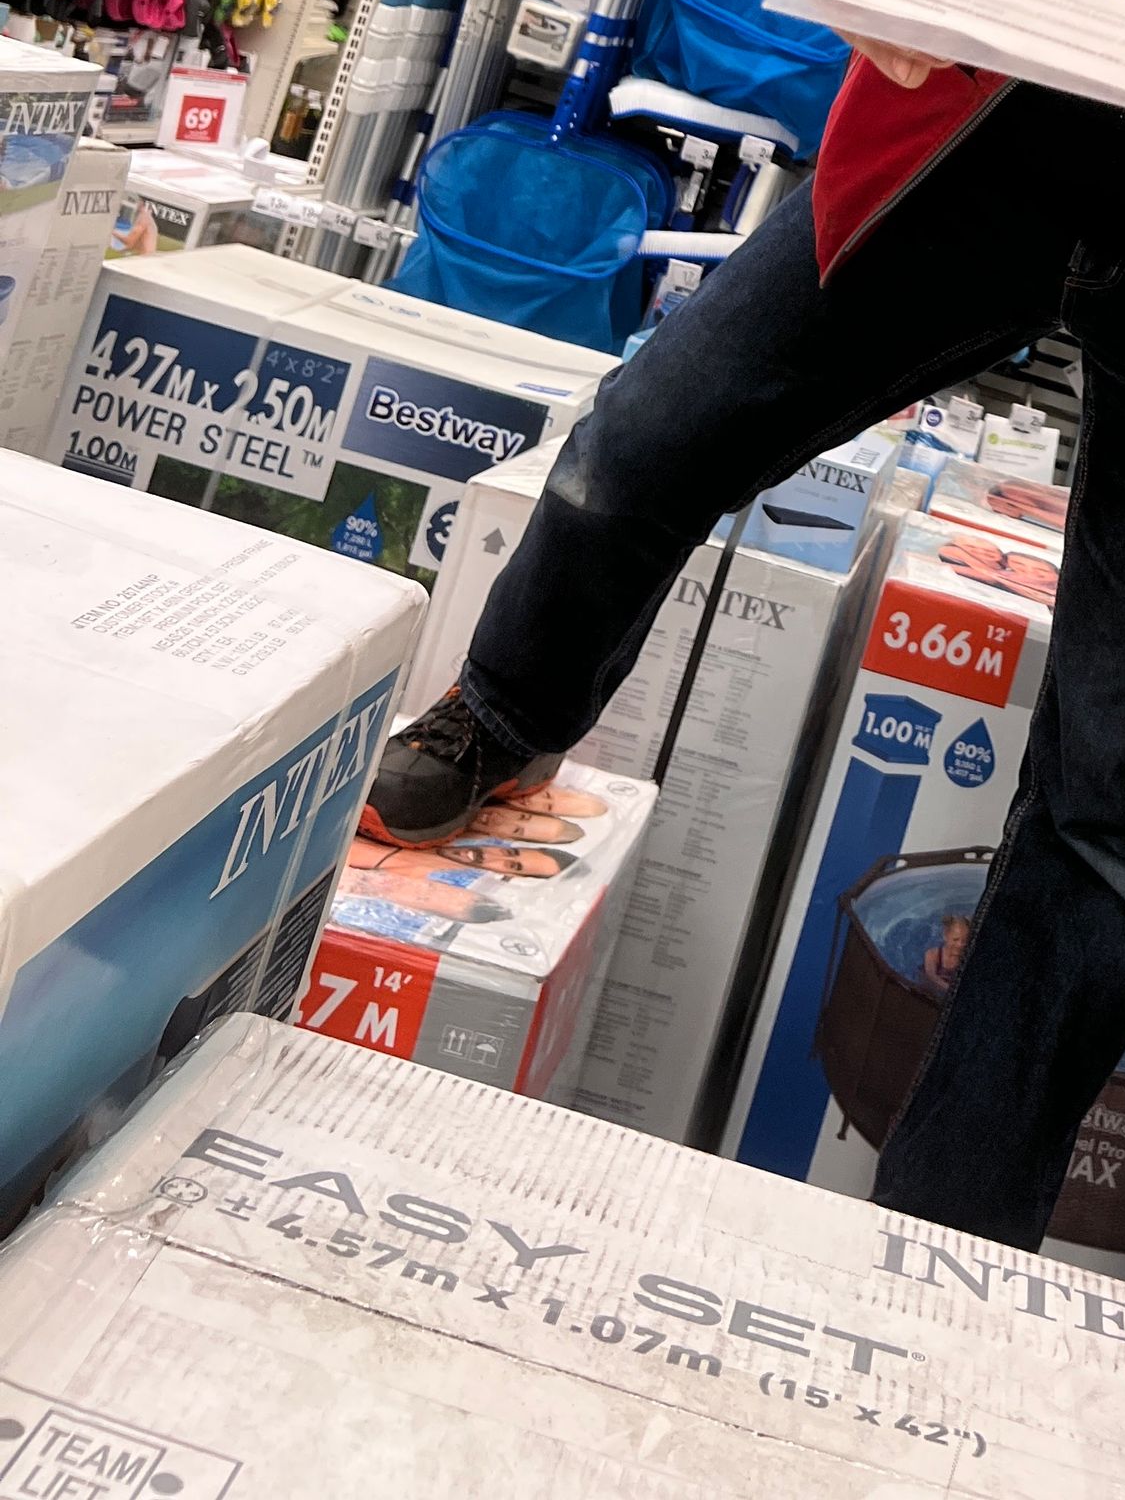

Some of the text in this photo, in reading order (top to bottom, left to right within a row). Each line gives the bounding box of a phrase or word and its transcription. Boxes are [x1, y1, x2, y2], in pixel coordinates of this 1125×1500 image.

[2, 101, 84, 135] INTEX
[60, 190, 117, 216] INTEX
[144, 201, 192, 227] INTEX
[72, 385, 187, 447] POWER
[200, 422, 297, 480] STEEL
[366, 385, 526, 463] Bestway
[797, 461, 871, 493] NTEX
[346, 515, 378, 538] 90%
[673, 576, 787, 632] INTEX
[883, 611, 973, 667] 3.66
[974, 647, 1004, 678] M
[864, 711, 931, 750] 1.00 M
[953, 740, 991, 764] 90%
[209, 687, 394, 900] INTEX
[355, 1006, 400, 1048] M
[1097, 1140, 1125, 1160] Pro
[182, 1127, 910, 1376] EASY SET
[473, 1286, 510, 1311] x
[541, 1298, 724, 1377] 1.07m
[855, 1404, 882, 1426] x
[39, 1426, 150, 1487] TEAM
[18, 1464, 111, 1500] LIFT
